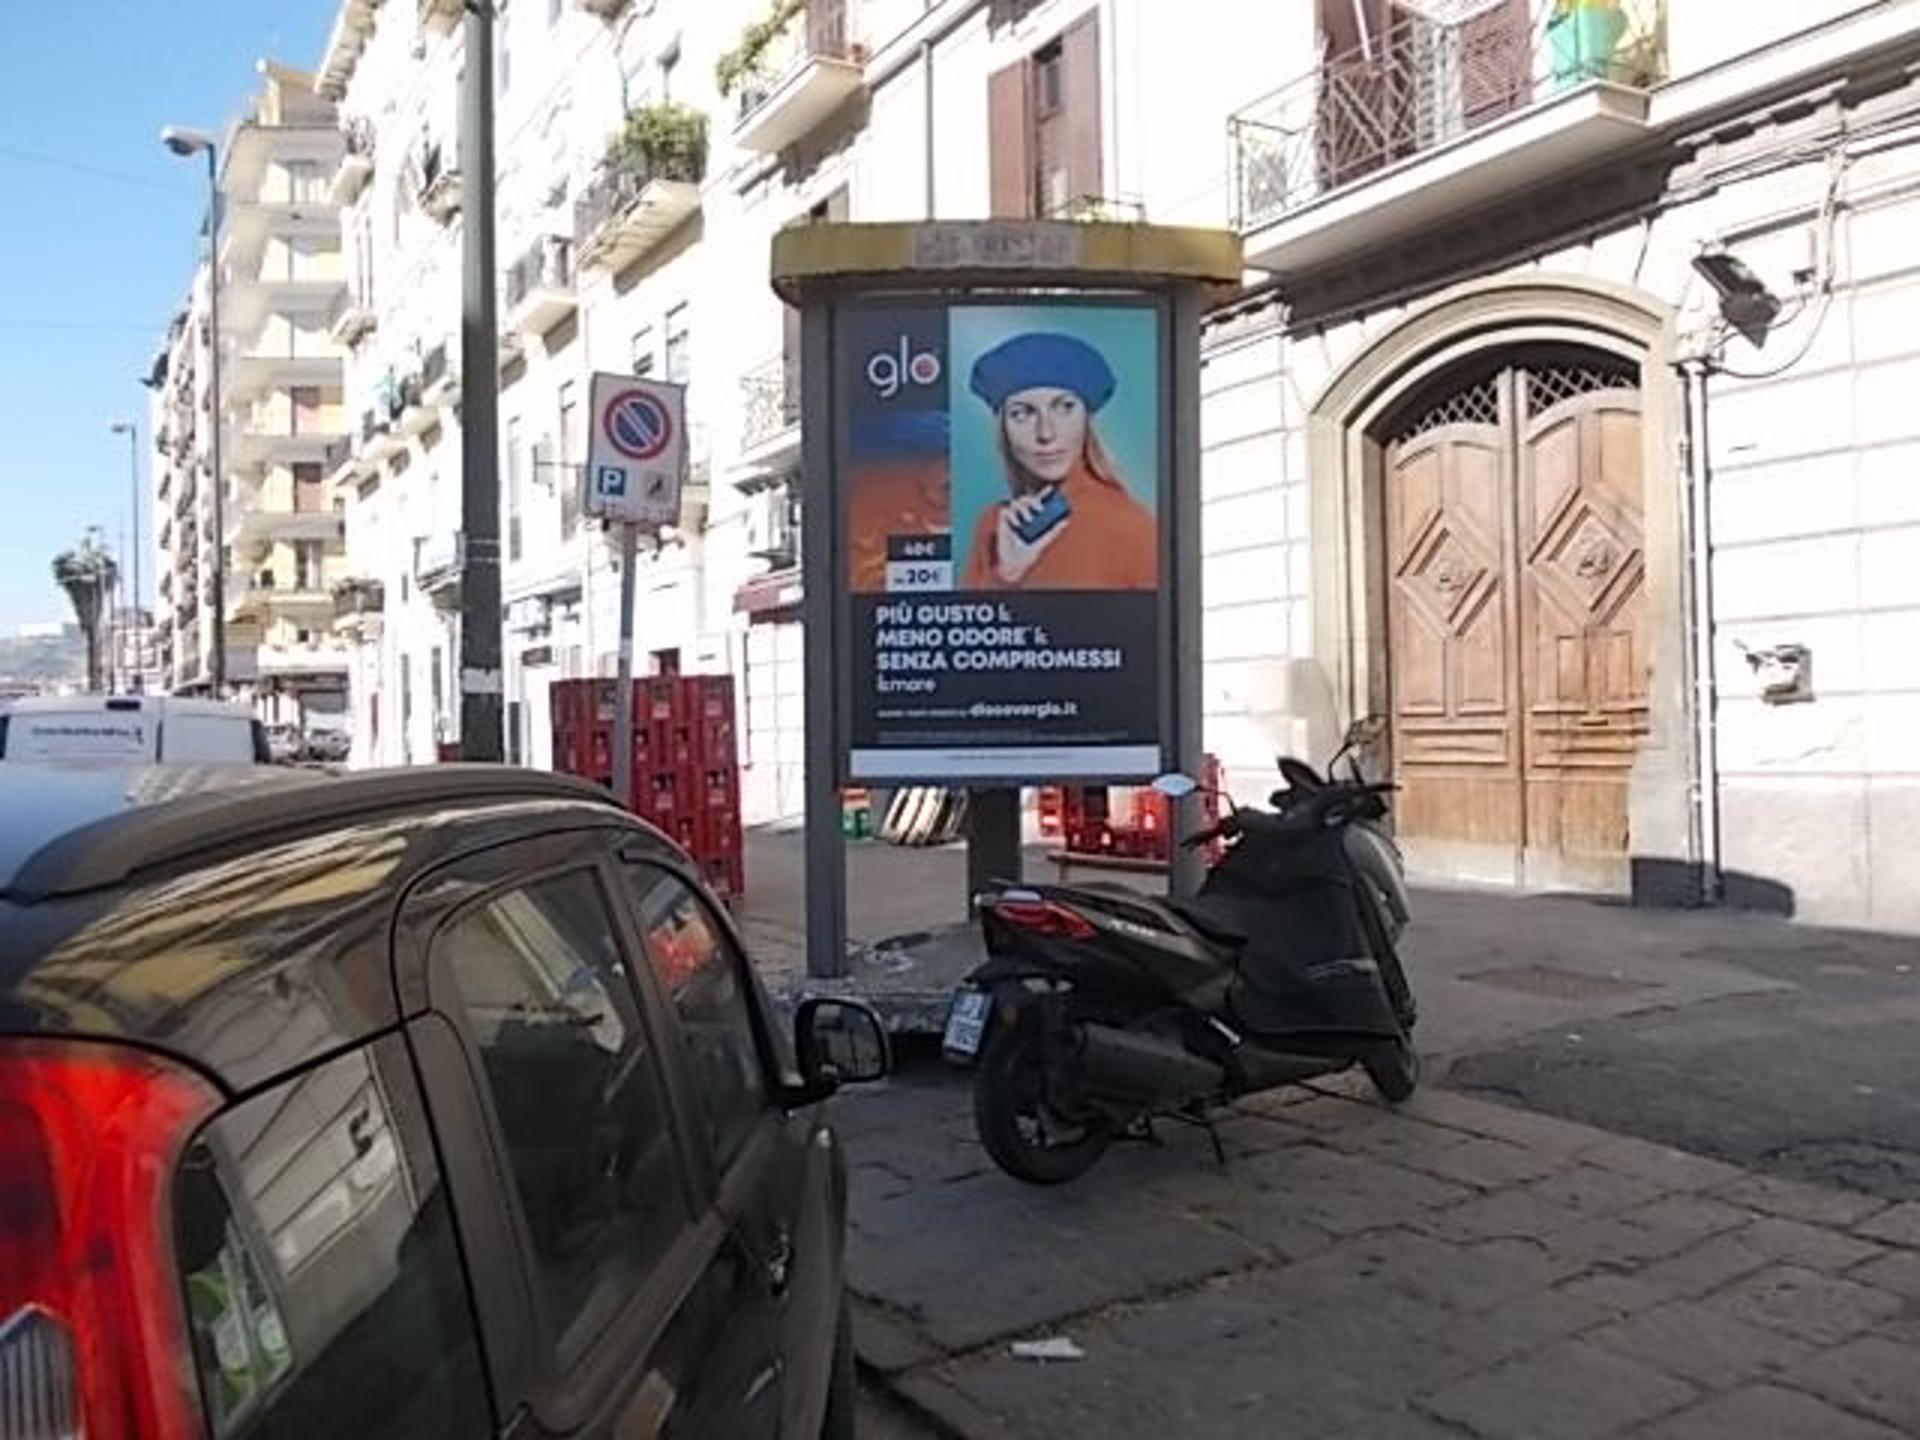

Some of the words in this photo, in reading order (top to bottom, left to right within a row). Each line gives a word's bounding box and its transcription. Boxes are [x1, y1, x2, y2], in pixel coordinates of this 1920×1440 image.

[867, 335, 940, 397] glo
[875, 603, 912, 624] PIÙ
[917, 604, 994, 623] GUSTO
[876, 629, 943, 646] MENO
[876, 652, 948, 670] SENZA
[953, 649, 1121, 669] COMPROMESSI
